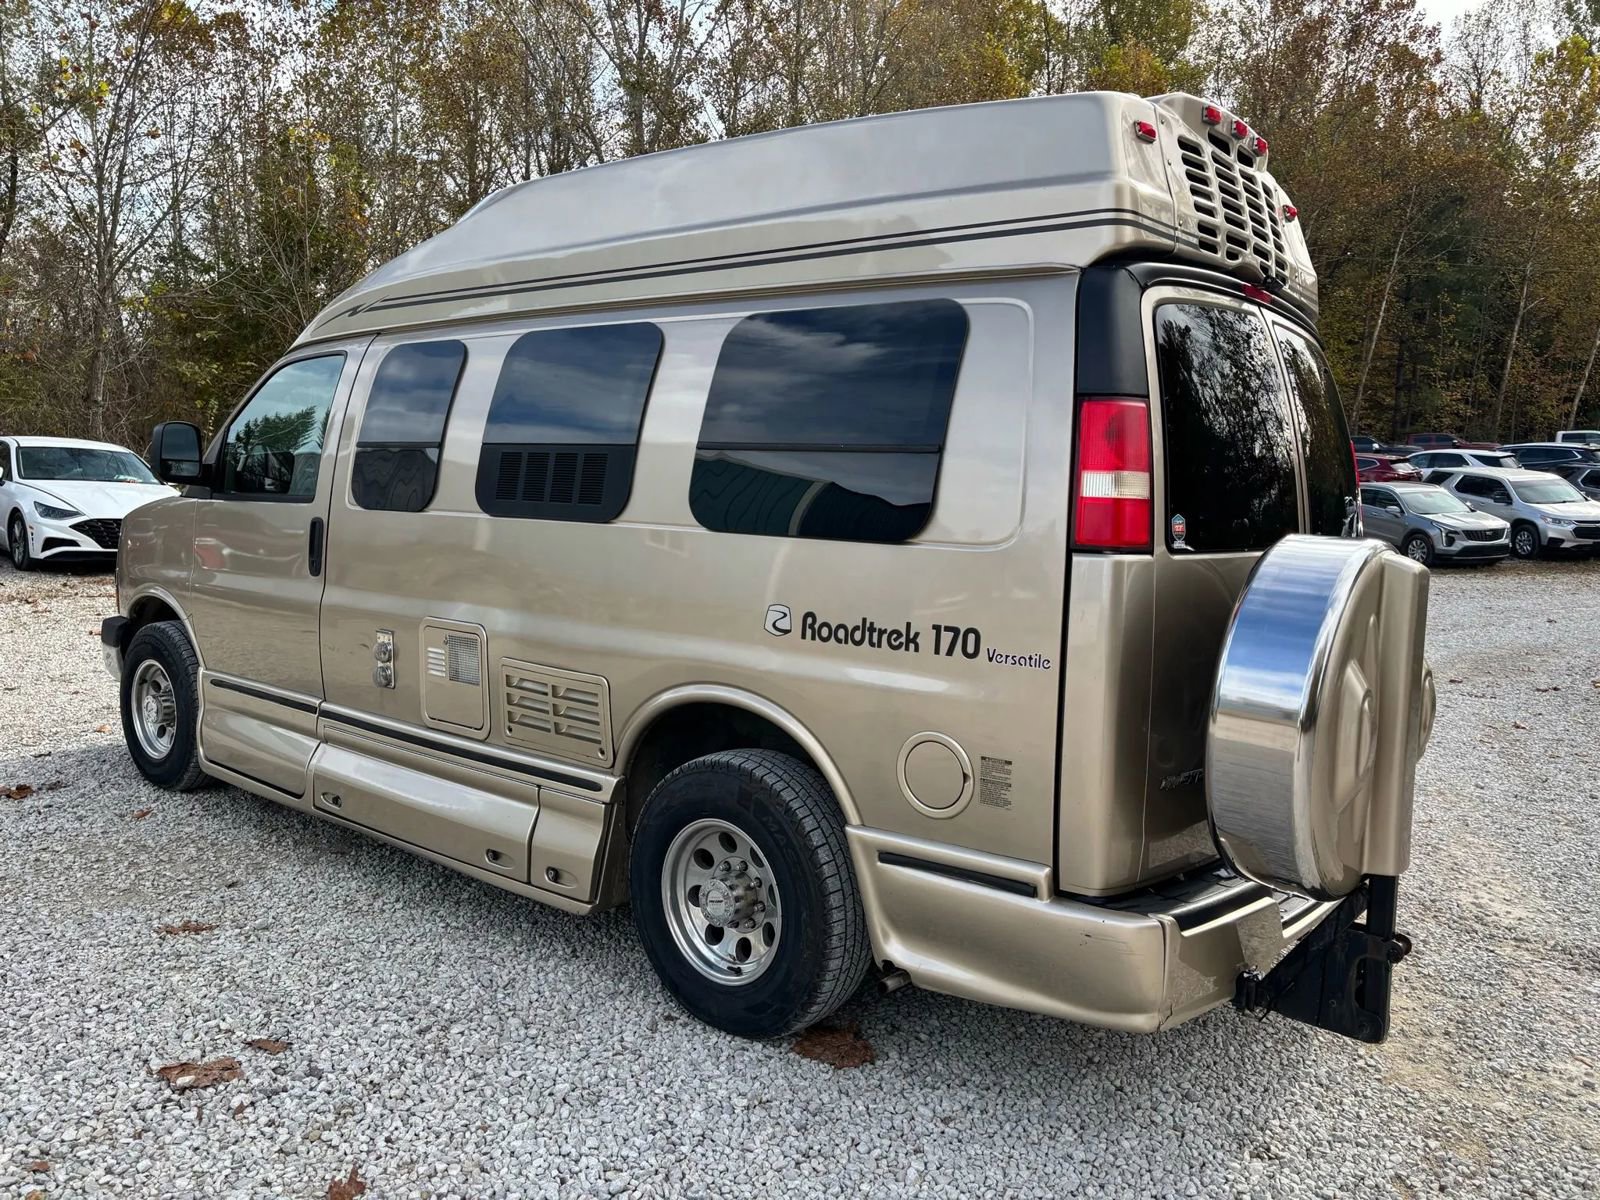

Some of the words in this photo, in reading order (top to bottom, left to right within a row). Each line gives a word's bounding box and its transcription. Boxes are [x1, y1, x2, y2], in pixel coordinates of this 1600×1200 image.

[800, 611, 920, 653] Roadtrek
[931, 624, 982, 660] 170
[986, 647, 1051, 670] Versatile
